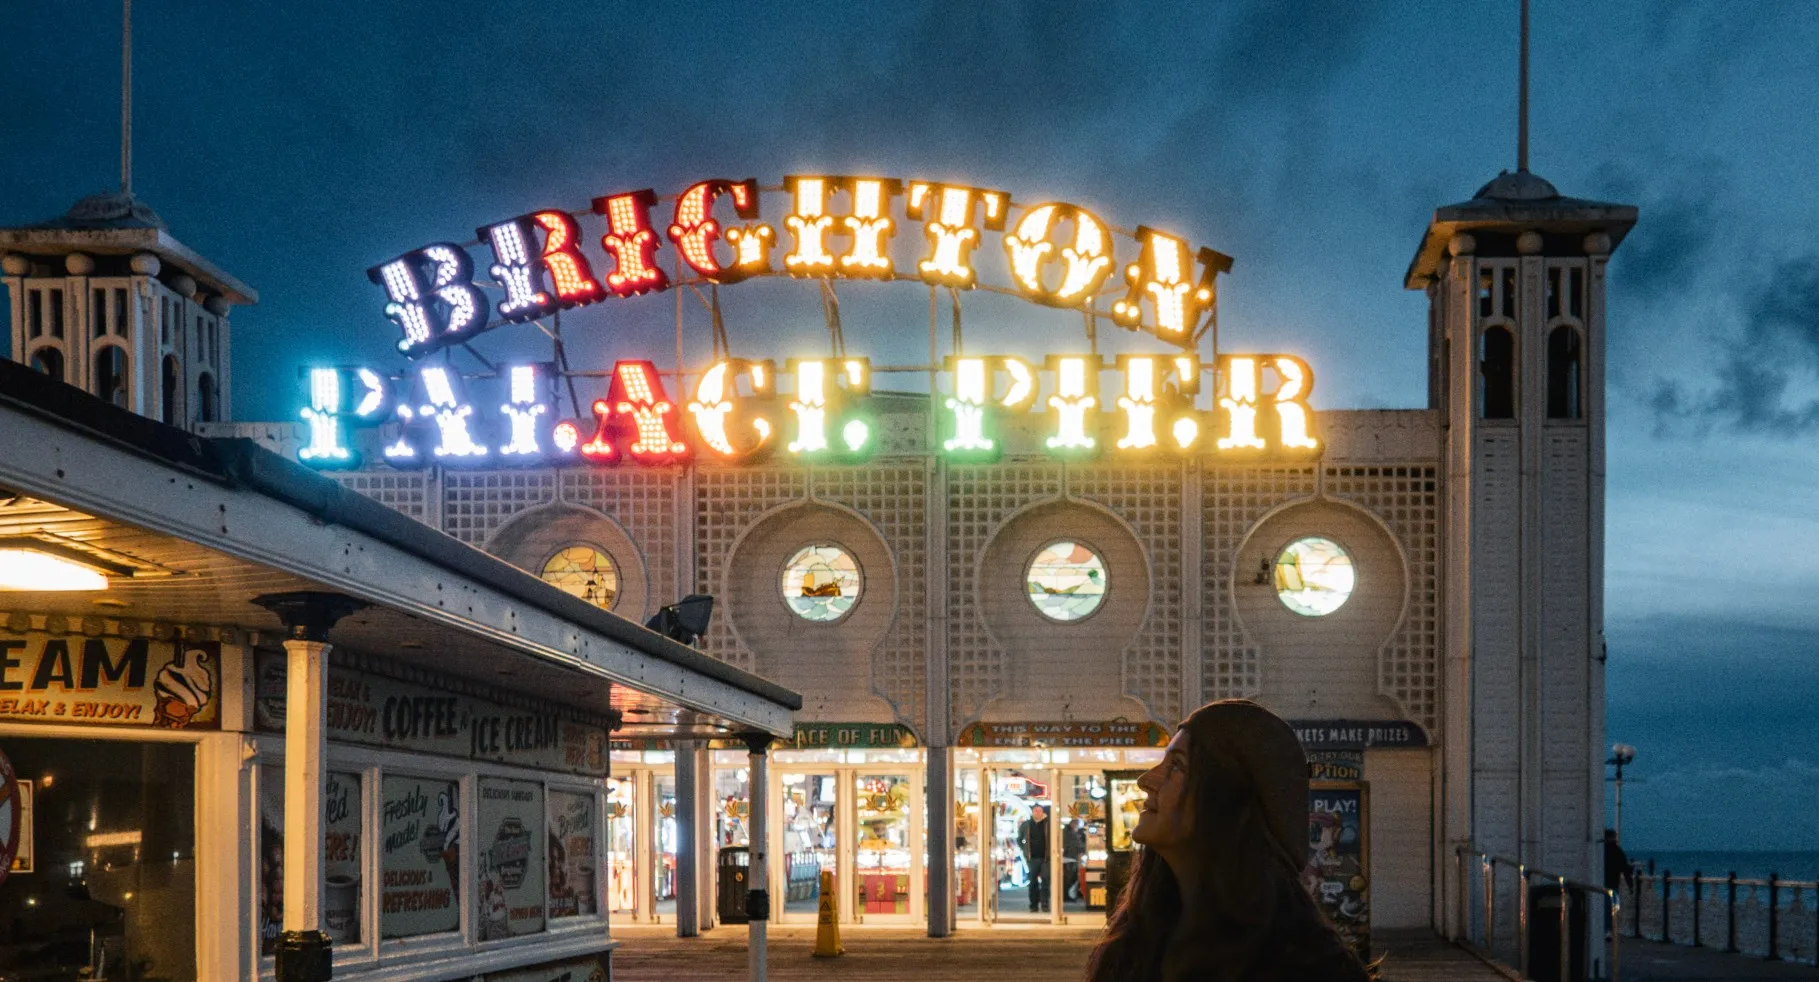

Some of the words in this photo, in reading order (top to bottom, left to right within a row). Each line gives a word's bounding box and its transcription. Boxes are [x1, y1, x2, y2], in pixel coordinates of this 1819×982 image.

[366, 176, 1234, 358] BRIGHTON
[300, 355, 872, 464] PALACE
[943, 353, 1325, 462] PIER
[54, 702, 67, 716] &
[71, 702, 143, 720] ENJOY!
[383, 695, 457, 740] COFFEE
[470, 717, 501, 760] ICE
[505, 714, 559, 753] CREAM
[991, 725, 1028, 733] THIS
[1033, 725, 1073, 733] WAY
[1080, 725, 1102, 733] TO
[1108, 725, 1139, 733] THE
[1293, 728, 1325, 742] KETS
[1329, 728, 1364, 742] MAKE
[1368, 728, 1410, 743] PRIZES
[798, 729, 827, 745] ACE
[838, 729, 859, 745] OF
[995, 737, 1029, 746] END
[1063, 737, 1094, 745] THE
[1099, 737, 1136, 746] PIER
[383, 785, 428, 827] Freshly
[1314, 800, 1357, 813] PLAY!
[386, 818, 420, 854] made!
[384, 870, 427, 888] DELICIOUS
[383, 888, 451, 914] REFRESHING
